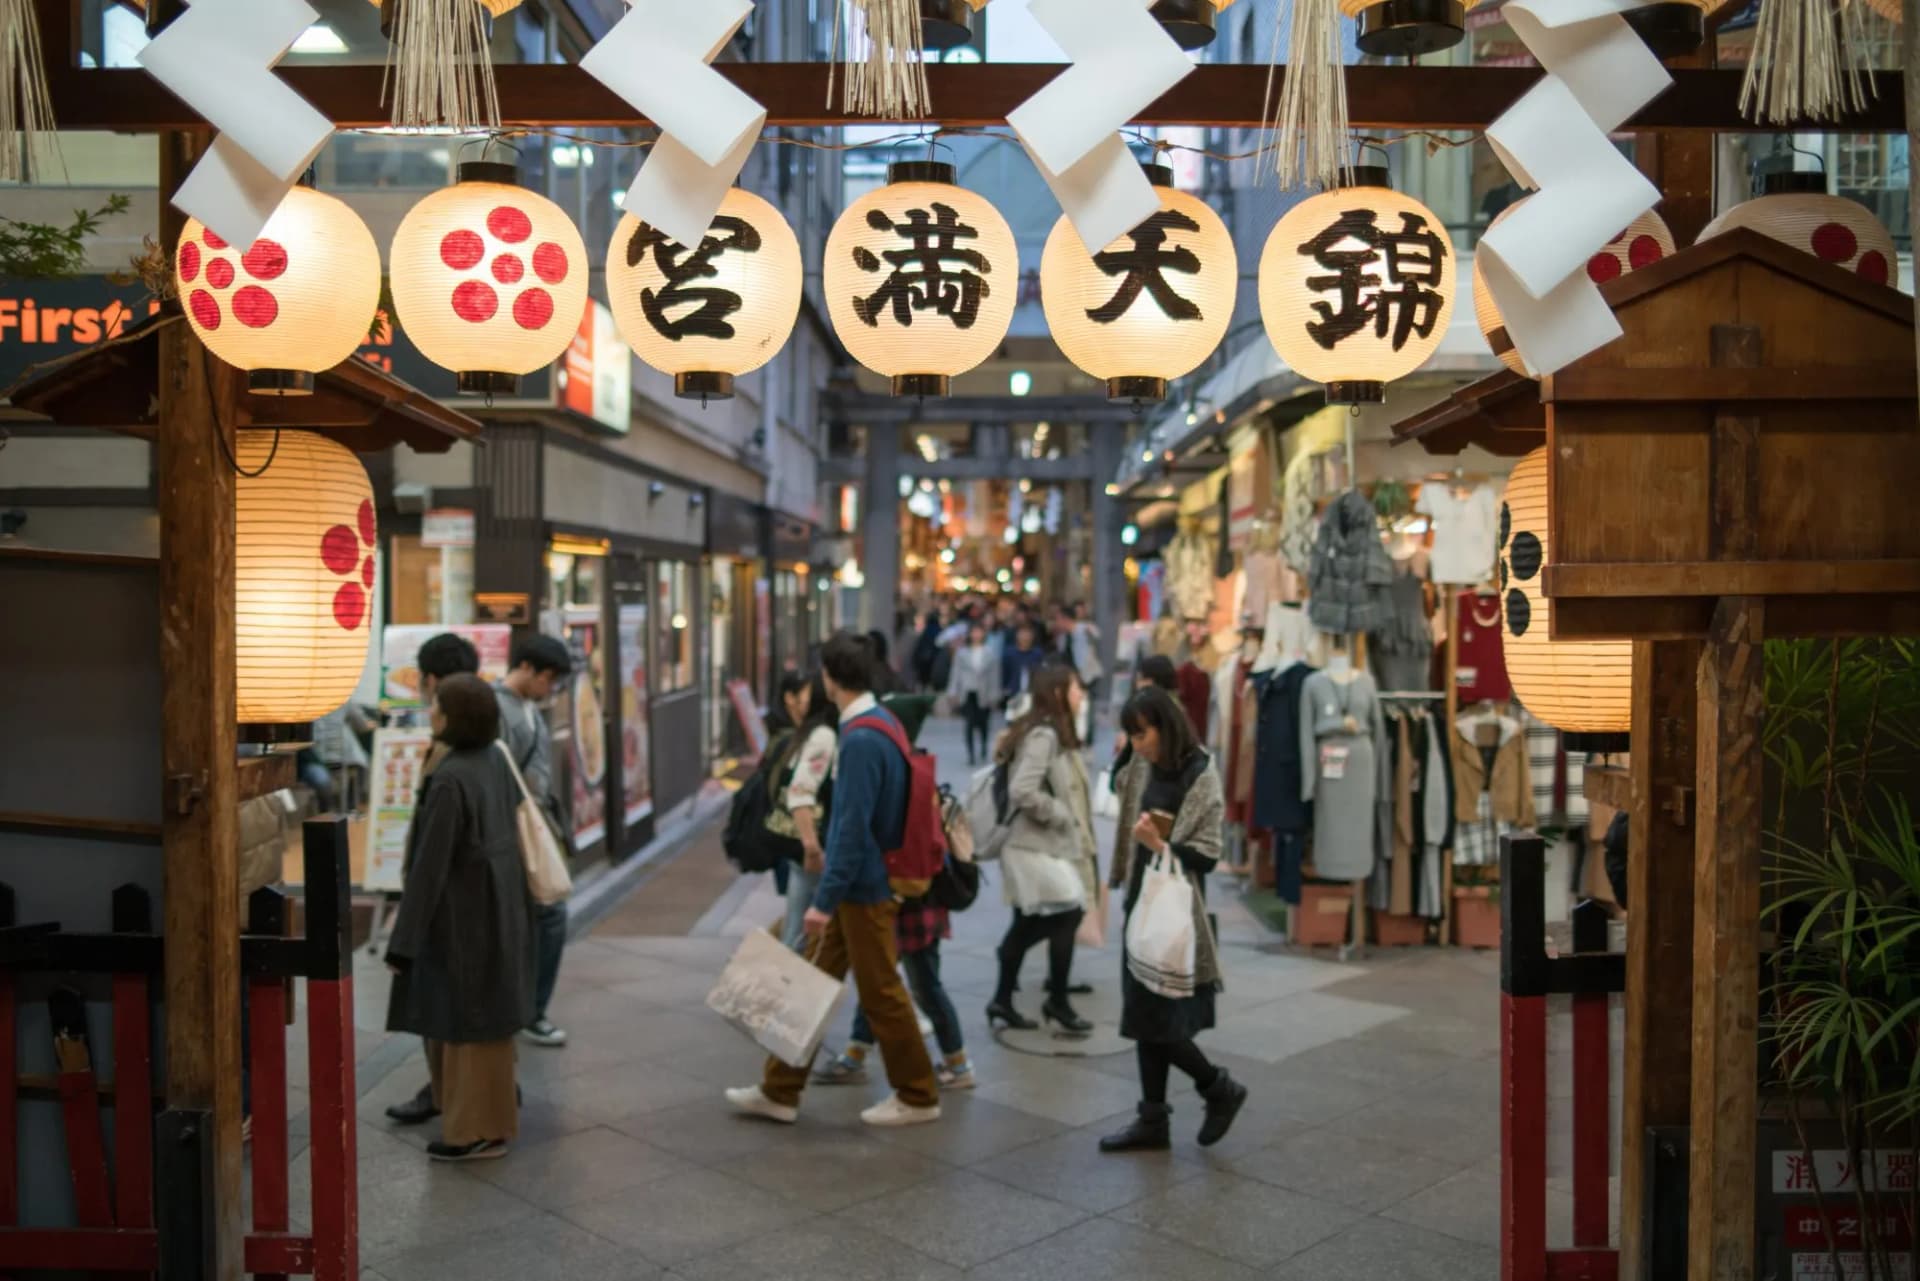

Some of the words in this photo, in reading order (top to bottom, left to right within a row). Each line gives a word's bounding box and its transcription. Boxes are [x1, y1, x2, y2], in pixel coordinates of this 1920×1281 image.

[0, 297, 133, 344] First
[626, 213, 762, 341] 宮
[851, 202, 992, 330] 満
[1085, 209, 1204, 324] 天
[1297, 208, 1447, 352] 錦
